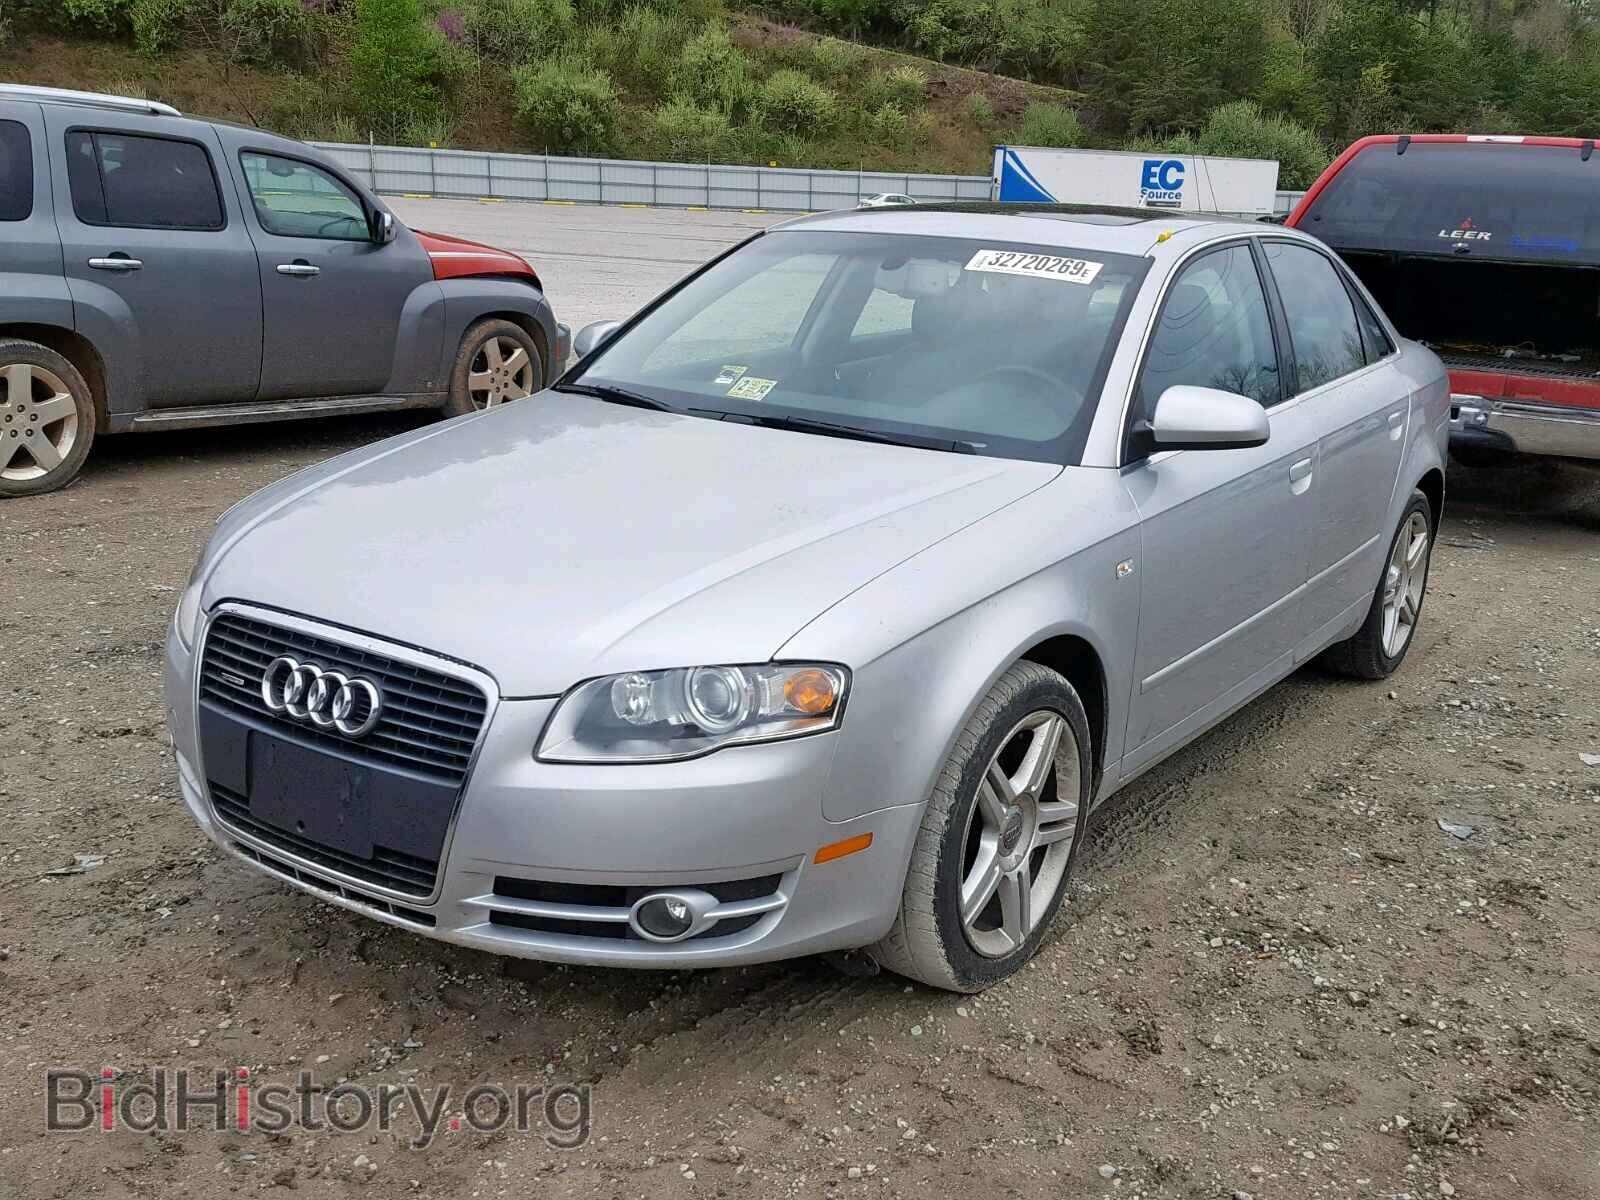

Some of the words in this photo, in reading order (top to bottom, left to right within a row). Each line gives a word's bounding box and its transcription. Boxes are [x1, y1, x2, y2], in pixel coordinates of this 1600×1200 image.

[1141, 160, 1185, 190] EC
[1140, 189, 1182, 200] Source
[1438, 230, 1491, 240] LEER
